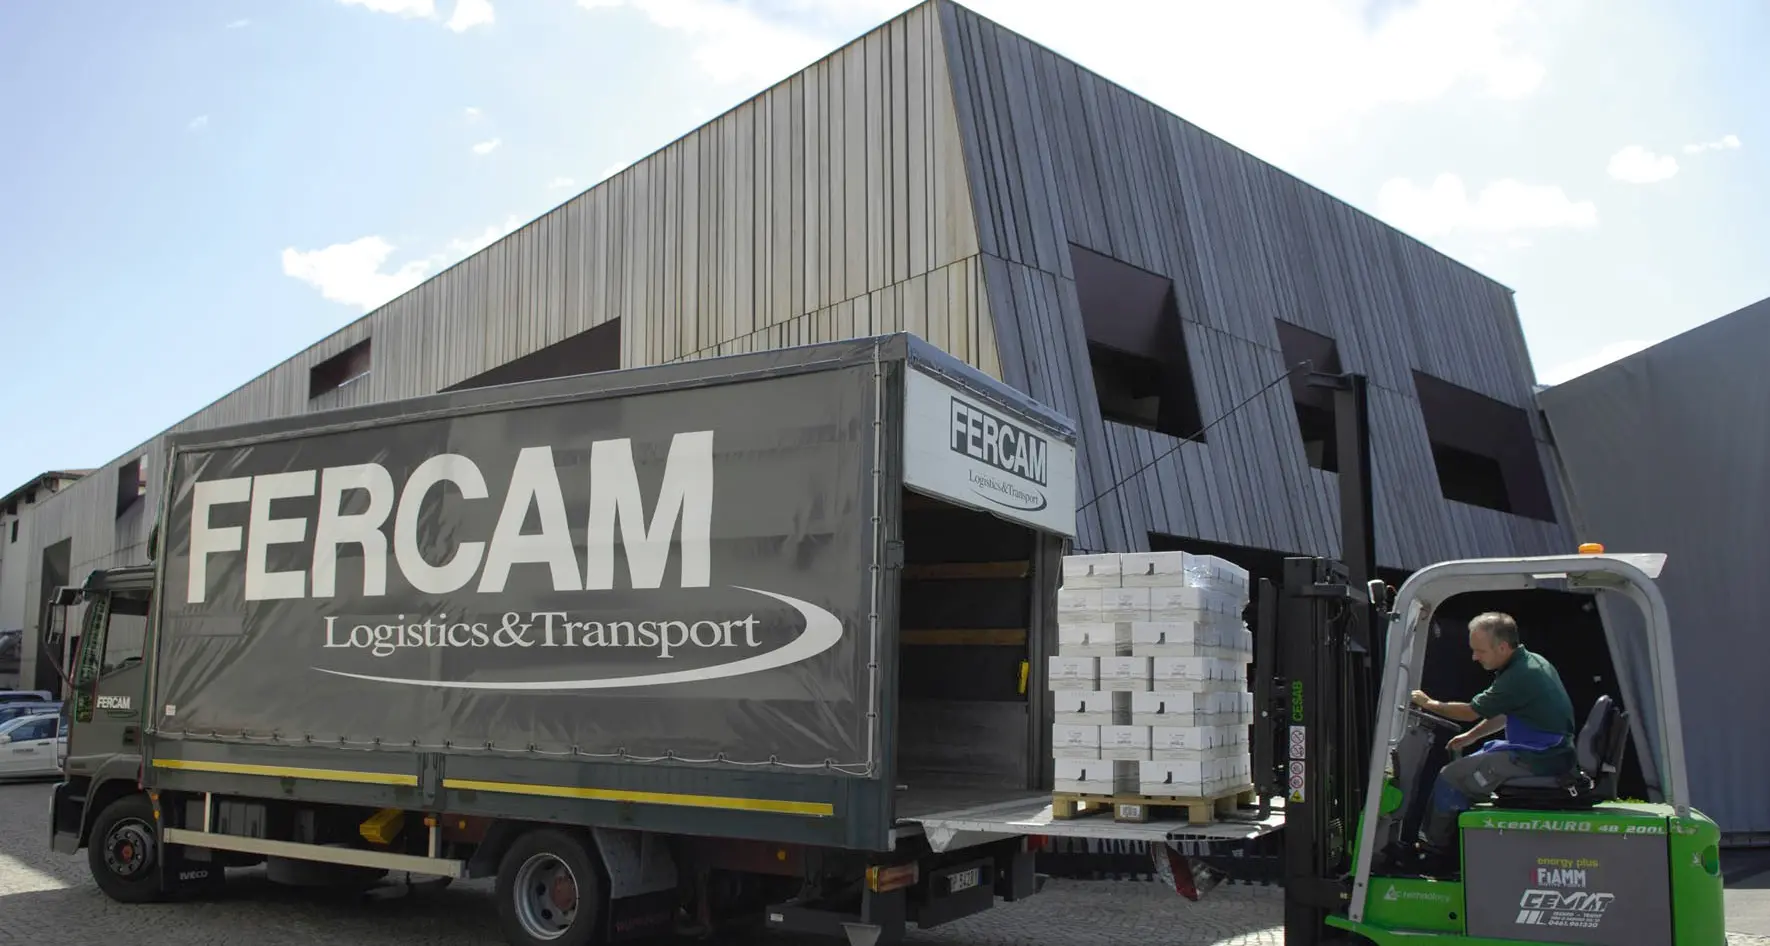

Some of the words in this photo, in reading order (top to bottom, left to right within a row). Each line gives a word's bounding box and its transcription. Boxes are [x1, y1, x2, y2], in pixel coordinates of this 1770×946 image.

[951, 399, 1046, 485] FERCAM
[969, 469, 1039, 505] Logistics&Transport
[186, 430, 714, 604] FERCAM
[323, 611, 762, 659] Logistics&Transport
[97, 696, 131, 709] FERCAM
[1291, 680, 1304, 721] CESAB
[179, 870, 209, 880] IVECO
[1536, 857, 1574, 869] energy
[1576, 858, 1599, 869] plus
